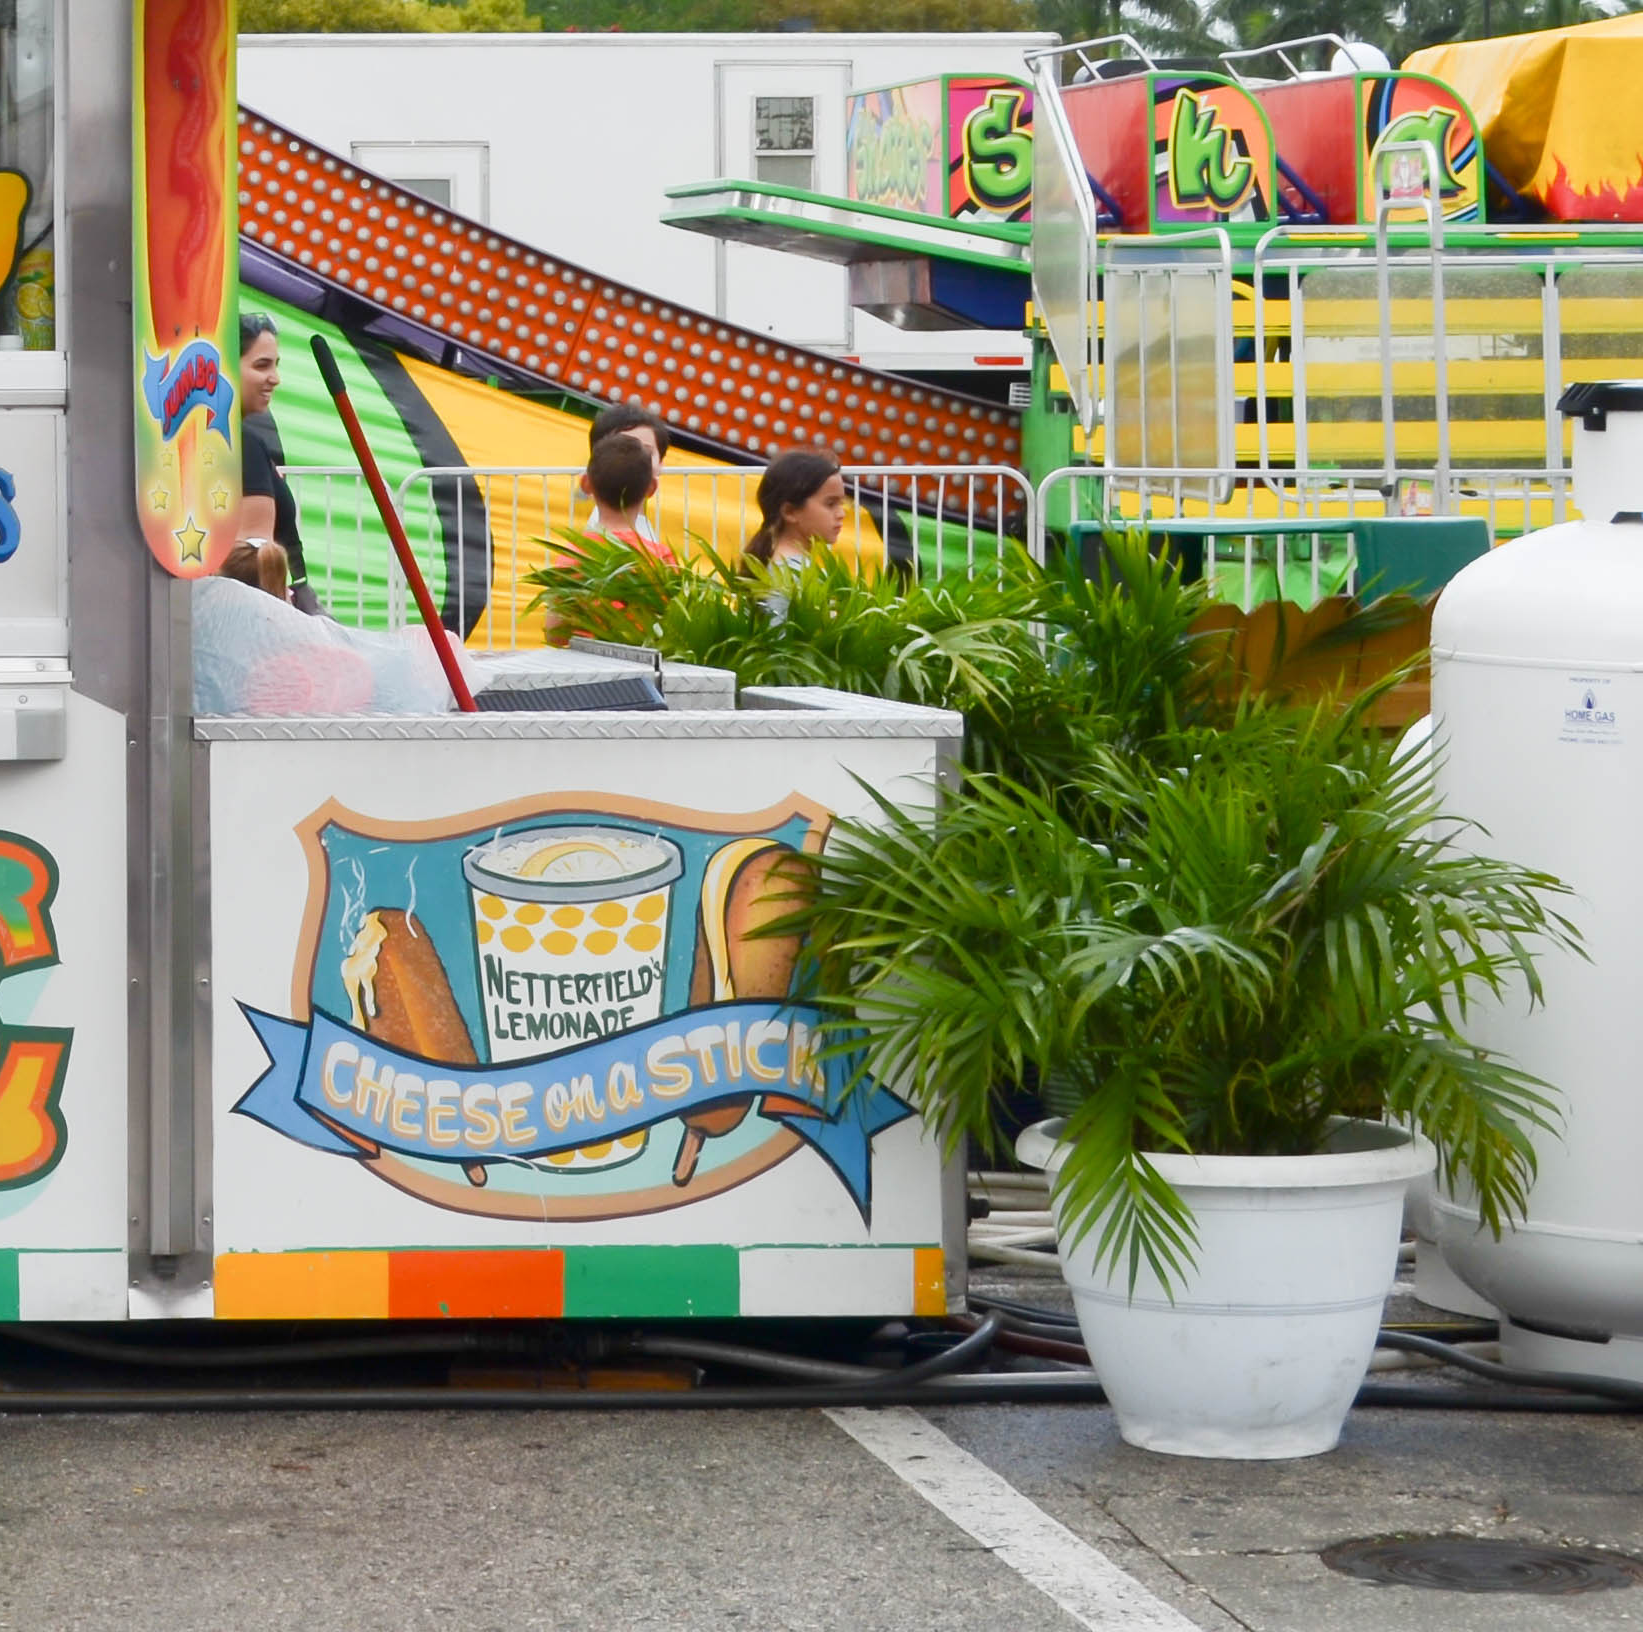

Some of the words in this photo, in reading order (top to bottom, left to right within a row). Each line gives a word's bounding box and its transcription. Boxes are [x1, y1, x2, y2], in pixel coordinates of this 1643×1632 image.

[163, 354, 219, 436] JUMBO
[483, 955, 666, 1008] NETTERFIELD'S
[493, 1004, 635, 1040] LEMONADE
[320, 1039, 538, 1151] CHEESE
[544, 1074, 607, 1132] on
[607, 1060, 644, 1112] a
[645, 1018, 827, 1105] STICK
